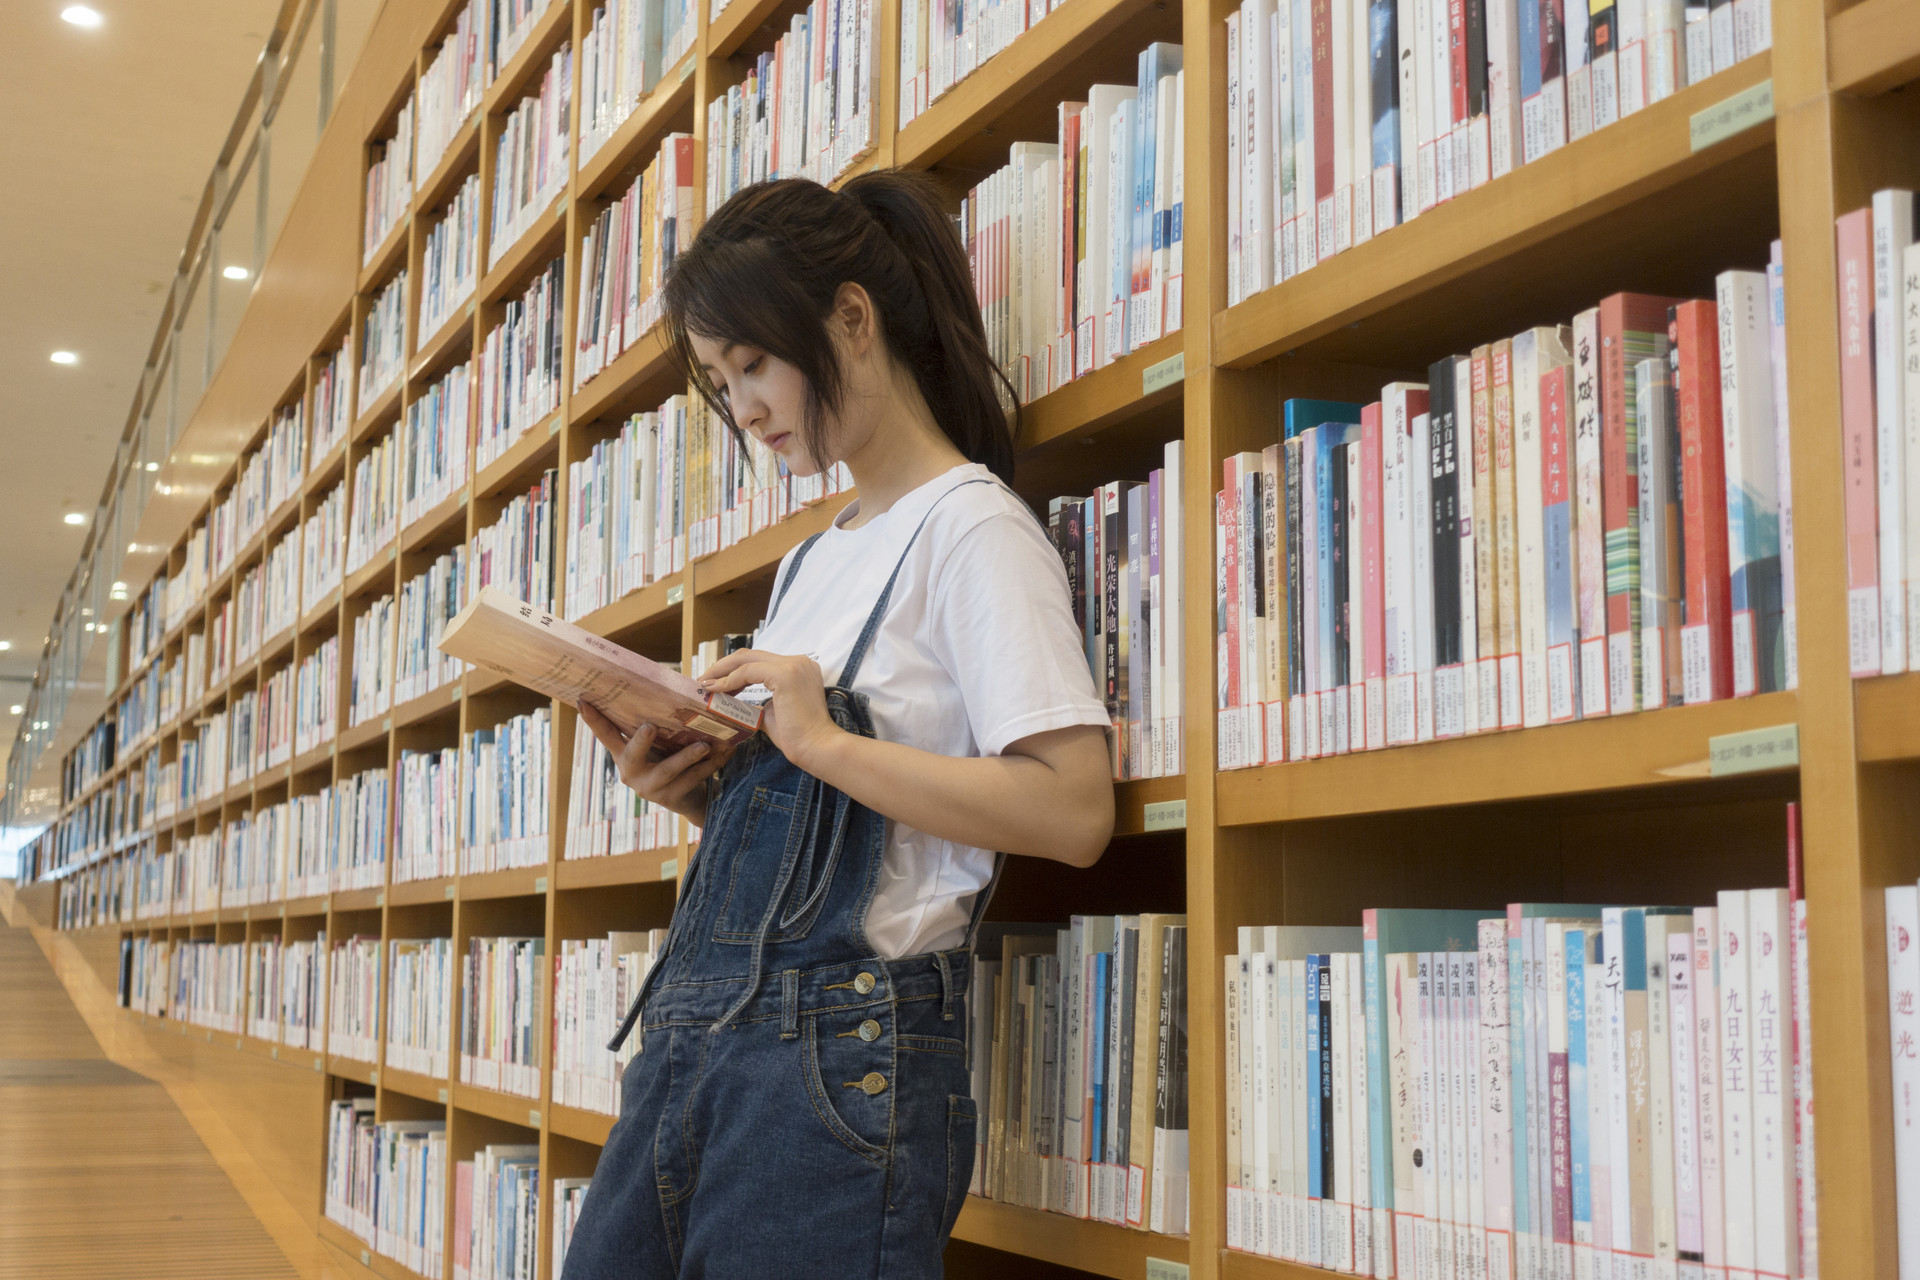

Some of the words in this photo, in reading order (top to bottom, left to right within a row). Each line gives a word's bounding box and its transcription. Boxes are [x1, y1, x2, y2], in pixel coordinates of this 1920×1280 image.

[1106, 553, 1117, 634] 光荣大地
[1308, 962, 1318, 1000] 5cm
[1418, 962, 1429, 998] 凌汛
[1434, 962, 1445, 998] 凌汛
[1450, 962, 1461, 998] 凌汛
[1465, 961, 1476, 997] 凌汛
[1605, 954, 1624, 1012] 天下
[1156, 991, 1170, 1110] 当时明月当时人
[1724, 987, 1745, 1094] 九日女王
[1756, 988, 1779, 1096] 九日女王
[1894, 988, 1917, 1060] 逆光
[1552, 1065, 1566, 1189] 春暖花开的时候
